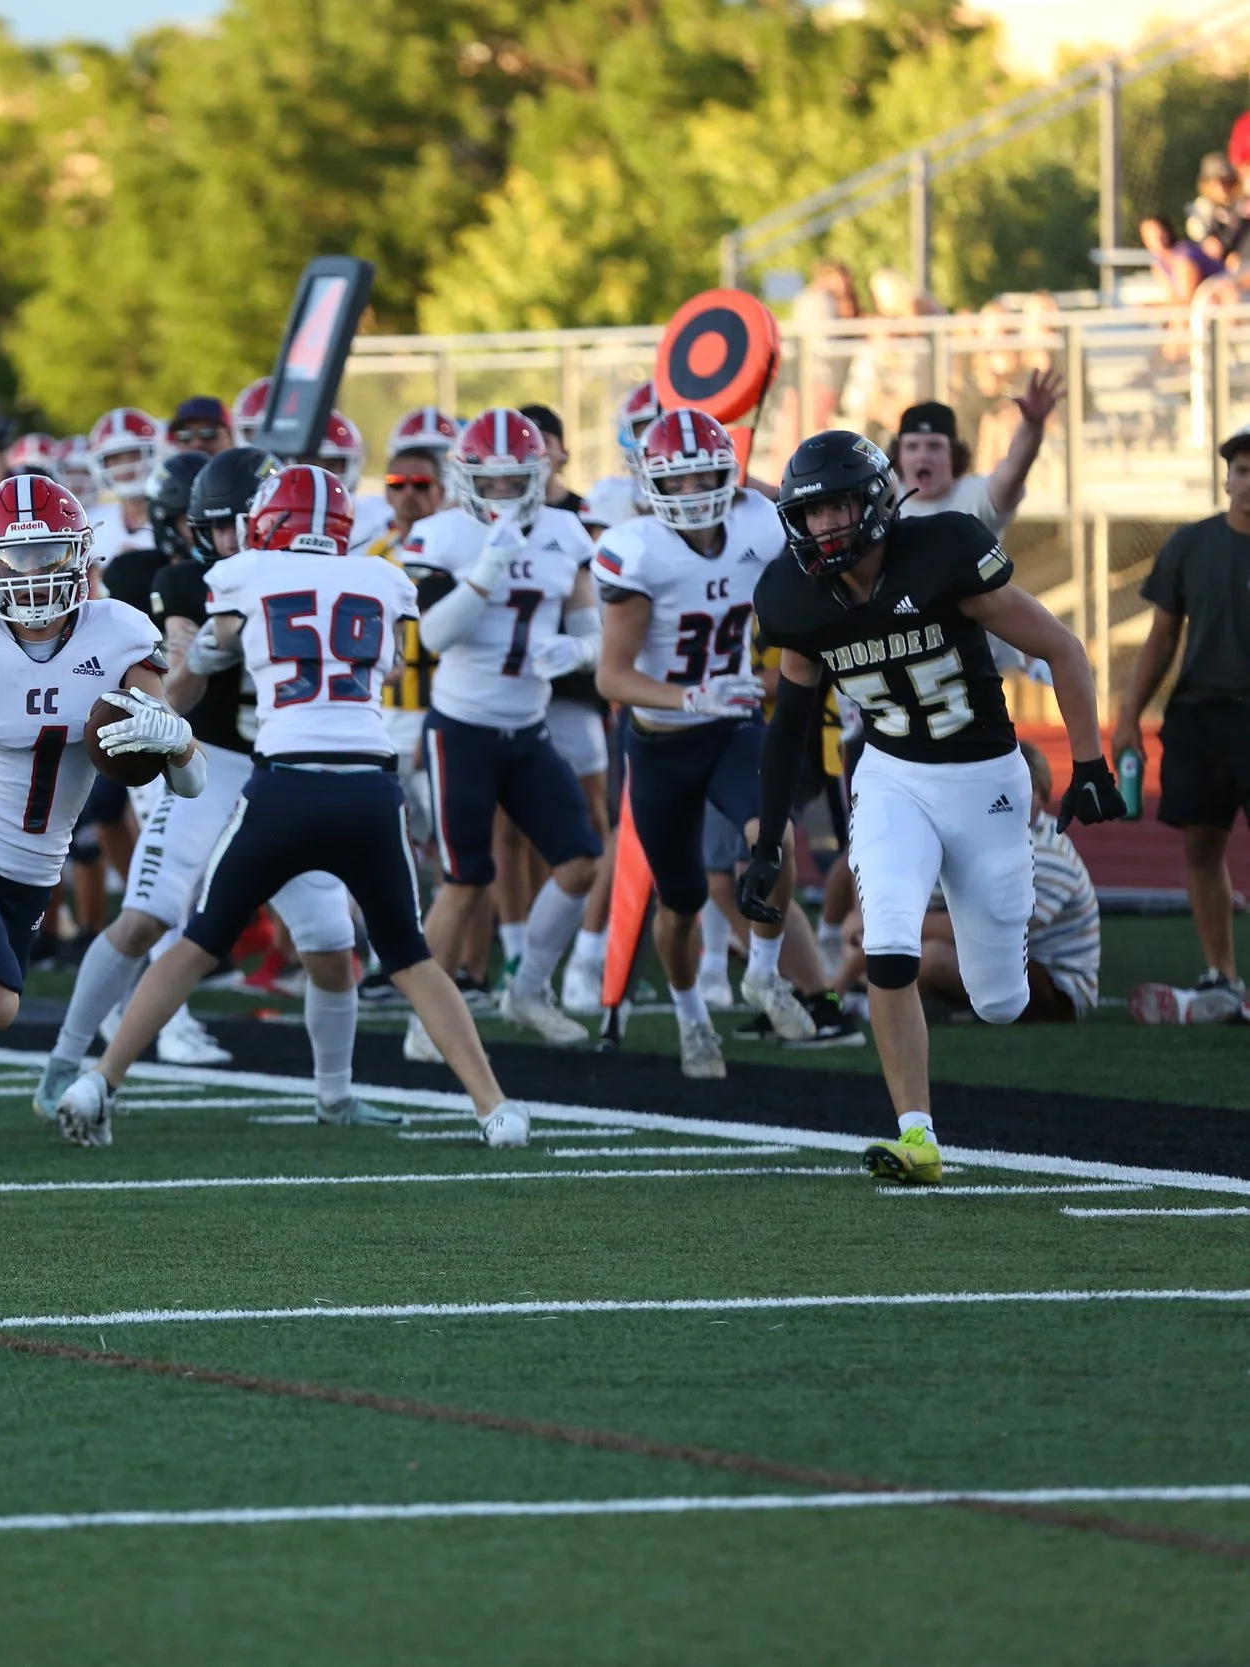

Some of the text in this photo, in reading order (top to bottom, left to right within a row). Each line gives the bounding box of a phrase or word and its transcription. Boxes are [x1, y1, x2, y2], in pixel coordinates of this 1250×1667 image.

[10, 521, 44, 532] Riddell
[509, 560, 533, 579] CC
[706, 576, 730, 602] CC
[261, 589, 385, 709] 59
[501, 587, 545, 677] 7
[666, 602, 754, 686] 39
[820, 623, 945, 672] THUNDER
[72, 666, 106, 678] adidas
[26, 687, 60, 716] CC
[838, 646, 975, 741] 55
[23, 725, 69, 835] 1
[987, 805, 1014, 815] adidas
